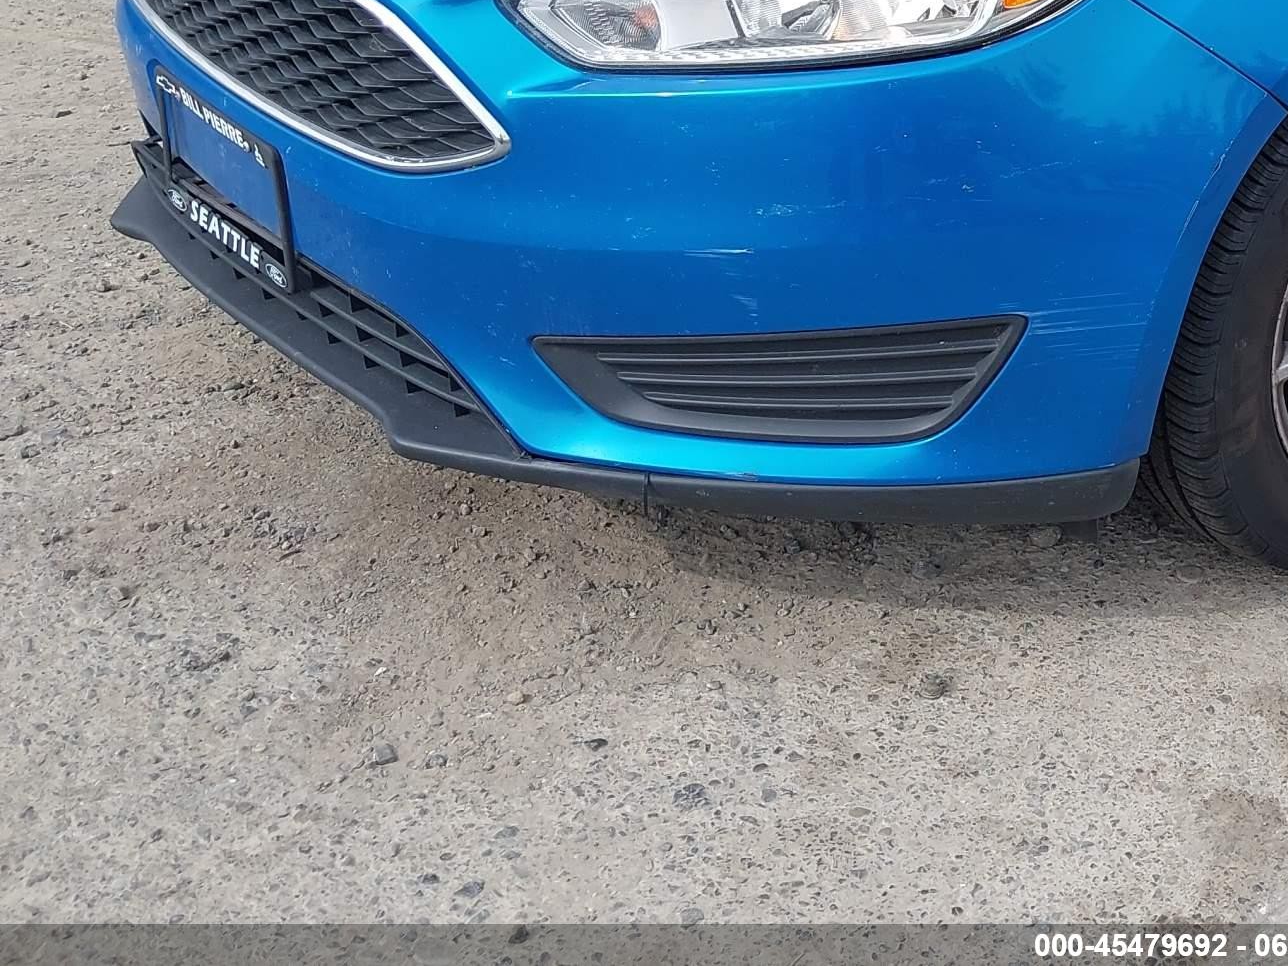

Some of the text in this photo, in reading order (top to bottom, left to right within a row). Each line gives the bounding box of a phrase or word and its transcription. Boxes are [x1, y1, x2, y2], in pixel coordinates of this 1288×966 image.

[179, 86, 245, 150] BILL PIERRE
[189, 199, 262, 271] SEATTLE
